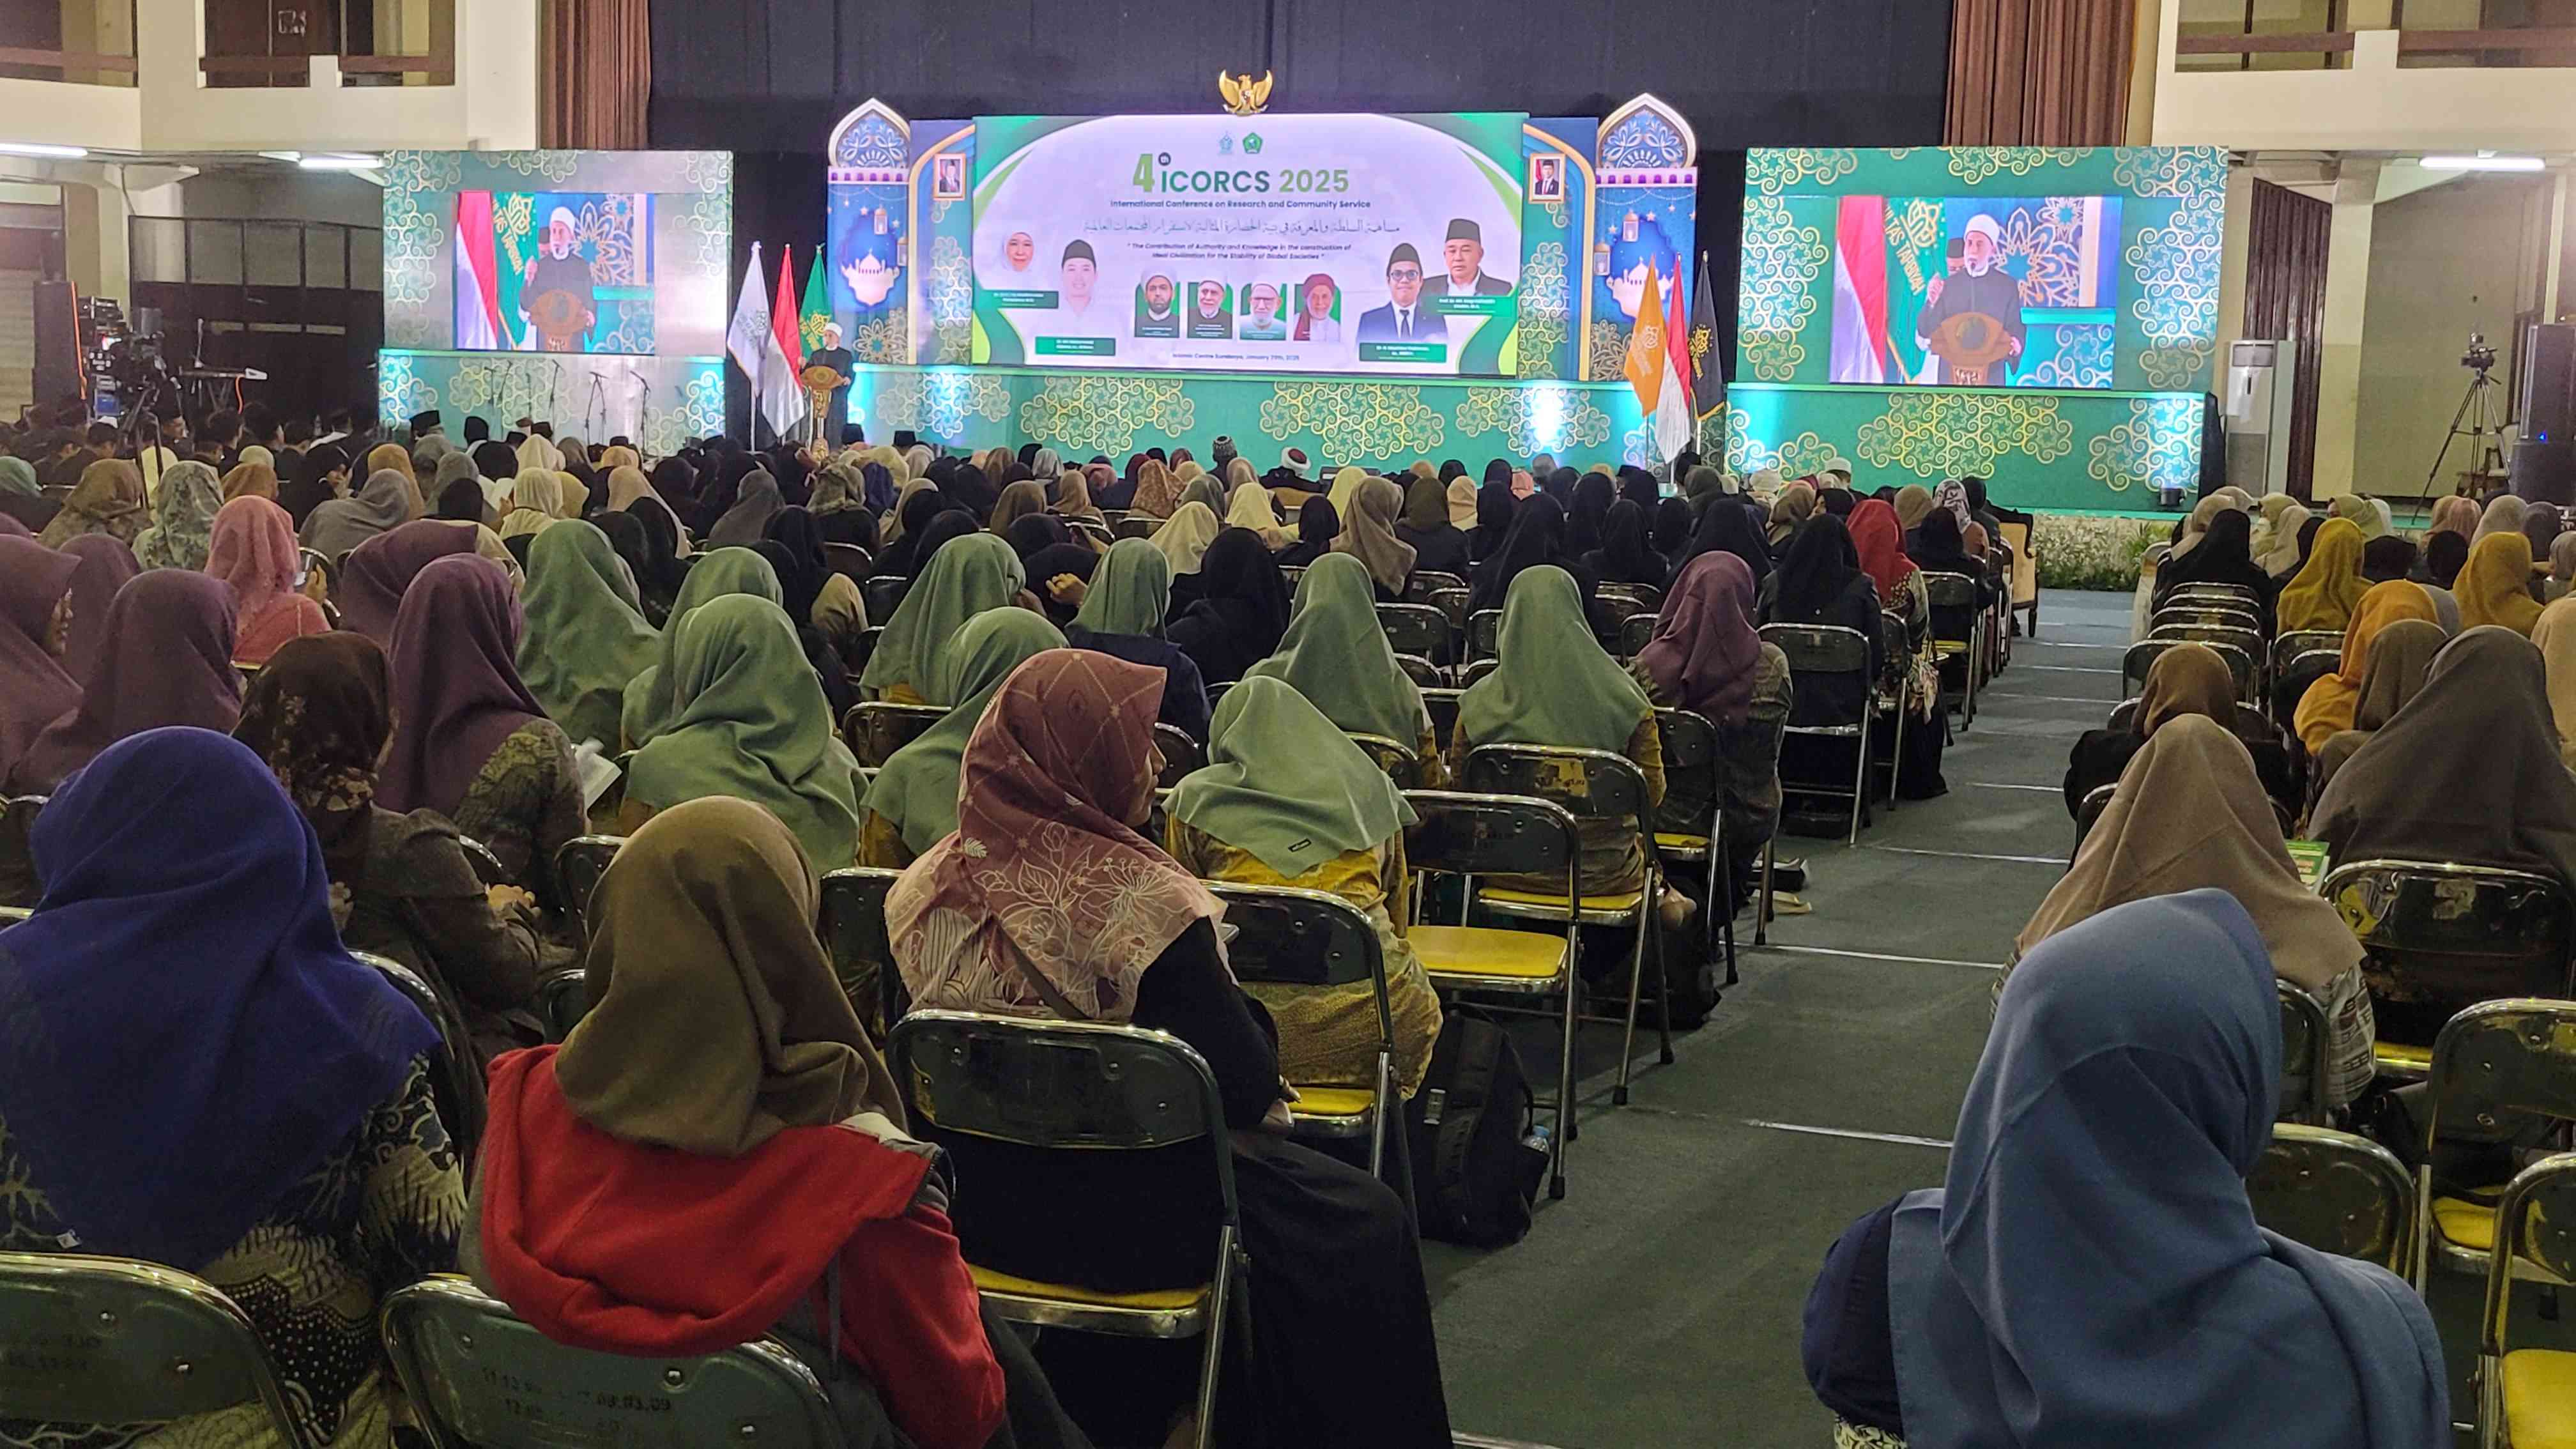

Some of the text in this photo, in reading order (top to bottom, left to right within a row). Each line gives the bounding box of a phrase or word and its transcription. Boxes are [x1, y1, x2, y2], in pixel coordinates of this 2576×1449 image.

[1279, 169, 1349, 193] 2025
[1165, 200, 1213, 208] Conference
[1227, 200, 1266, 208] Research
[1286, 200, 1338, 210] Community
[1339, 200, 1371, 209] Service
